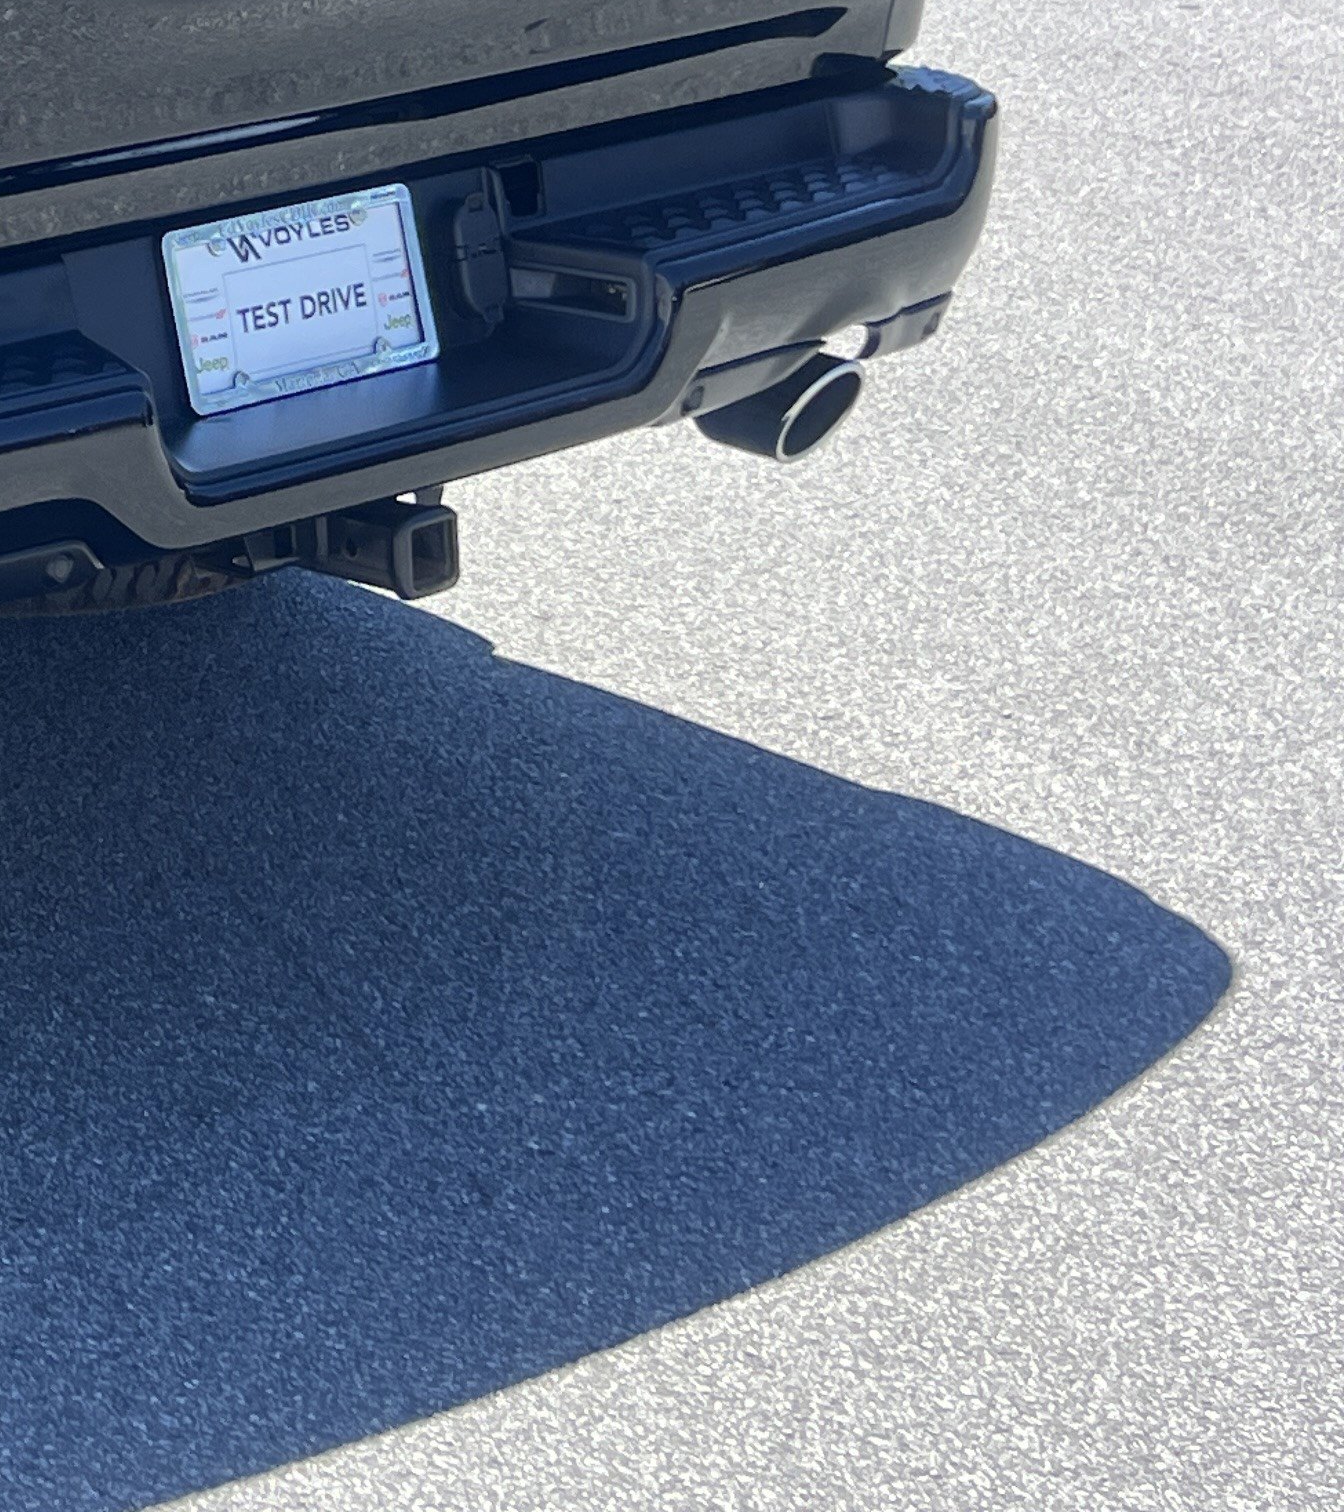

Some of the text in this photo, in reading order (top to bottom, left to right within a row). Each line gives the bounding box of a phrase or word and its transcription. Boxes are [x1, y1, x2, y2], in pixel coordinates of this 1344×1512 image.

[258, 213, 351, 247] VOYLES
[237, 283, 368, 333] TEST DRIVE
